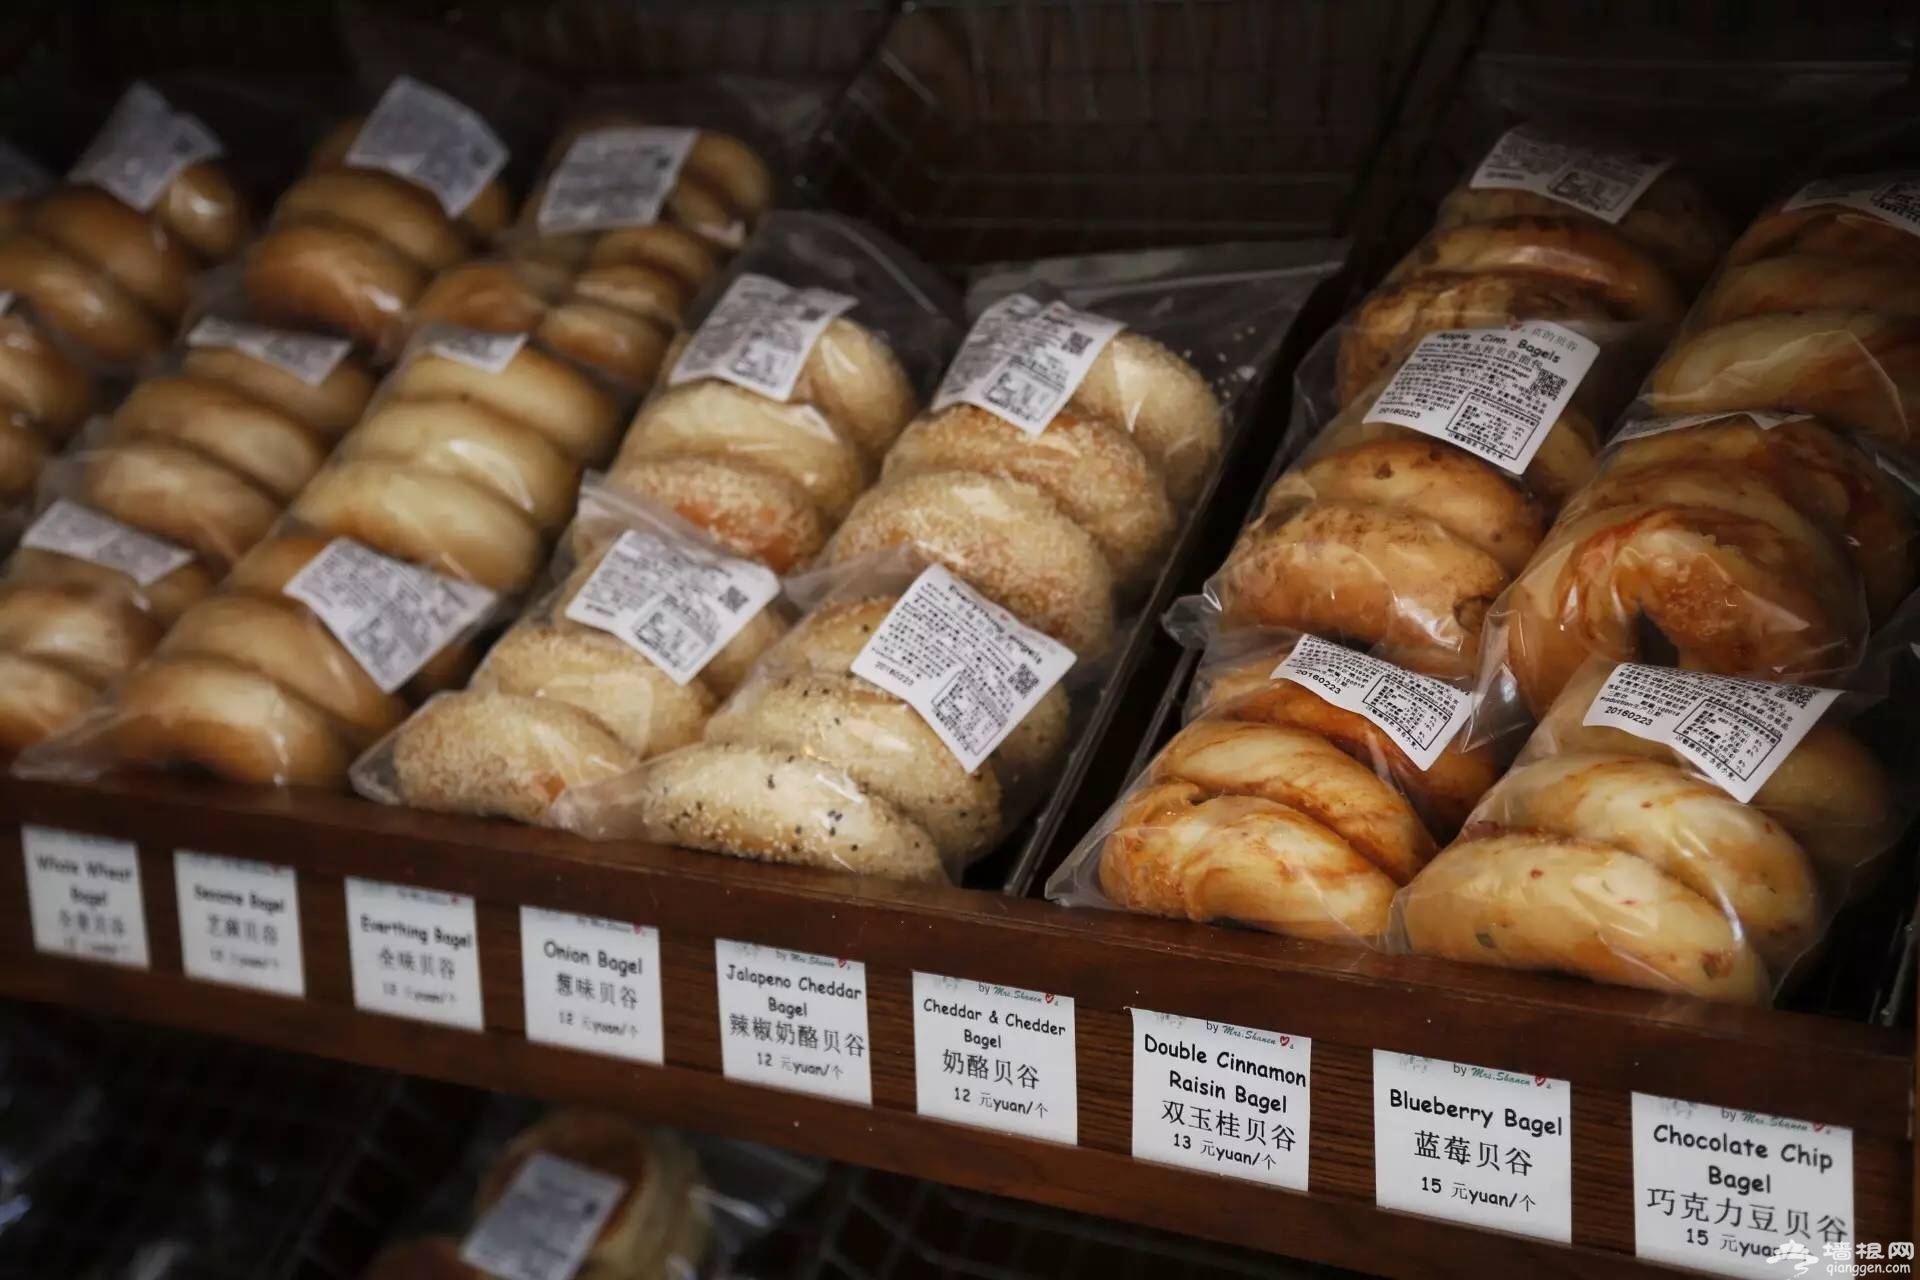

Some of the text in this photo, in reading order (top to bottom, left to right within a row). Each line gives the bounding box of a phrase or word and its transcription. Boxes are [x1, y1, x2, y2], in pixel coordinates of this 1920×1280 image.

[1517, 338, 1561, 364] Bagels
[1295, 669, 1341, 695] 20160223
[1604, 706, 1653, 726] 20160223
[249, 890, 285, 916] Bagel
[433, 925, 472, 951] Bagel
[380, 945, 455, 980] 全味贝谷
[543, 940, 642, 977] Onion Bagel
[556, 973, 638, 1010] 葱味贝谷
[726, 963, 863, 1000] Jalapeno Cheddar
[978, 983, 991, 995] by
[559, 1010, 574, 1026] 12
[768, 996, 808, 1020] Bagel
[923, 998, 1066, 1036] Cheddar & Chedder
[729, 1012, 866, 1058] 辣椒奶酪贝谷
[963, 1028, 1002, 1050] Bagel
[1206, 1020, 1219, 1034] by
[757, 1052, 773, 1067] 12
[941, 1048, 1040, 1090] 奶酪贝谷
[1144, 1033, 1307, 1088] Double Cinnamon
[1453, 1063, 1467, 1077] by
[954, 1087, 972, 1103] 12
[1169, 1070, 1287, 1114] Raisin Bagel
[1161, 1099, 1296, 1151] 双玉桂贝谷
[1390, 1088, 1562, 1138] Blueberry Bagel
[1721, 1107, 1737, 1122] by
[1173, 1133, 1192, 1149] 13
[1414, 1130, 1533, 1176] 蓝莓贝谷
[1653, 1124, 1833, 1173] Chocolate Chip
[1421, 1176, 1442, 1193] 15
[1708, 1165, 1771, 1196] Bagel
[1647, 1188, 1848, 1243] 巧克力豆贝谷
[1686, 1228, 1709, 1246] 15
